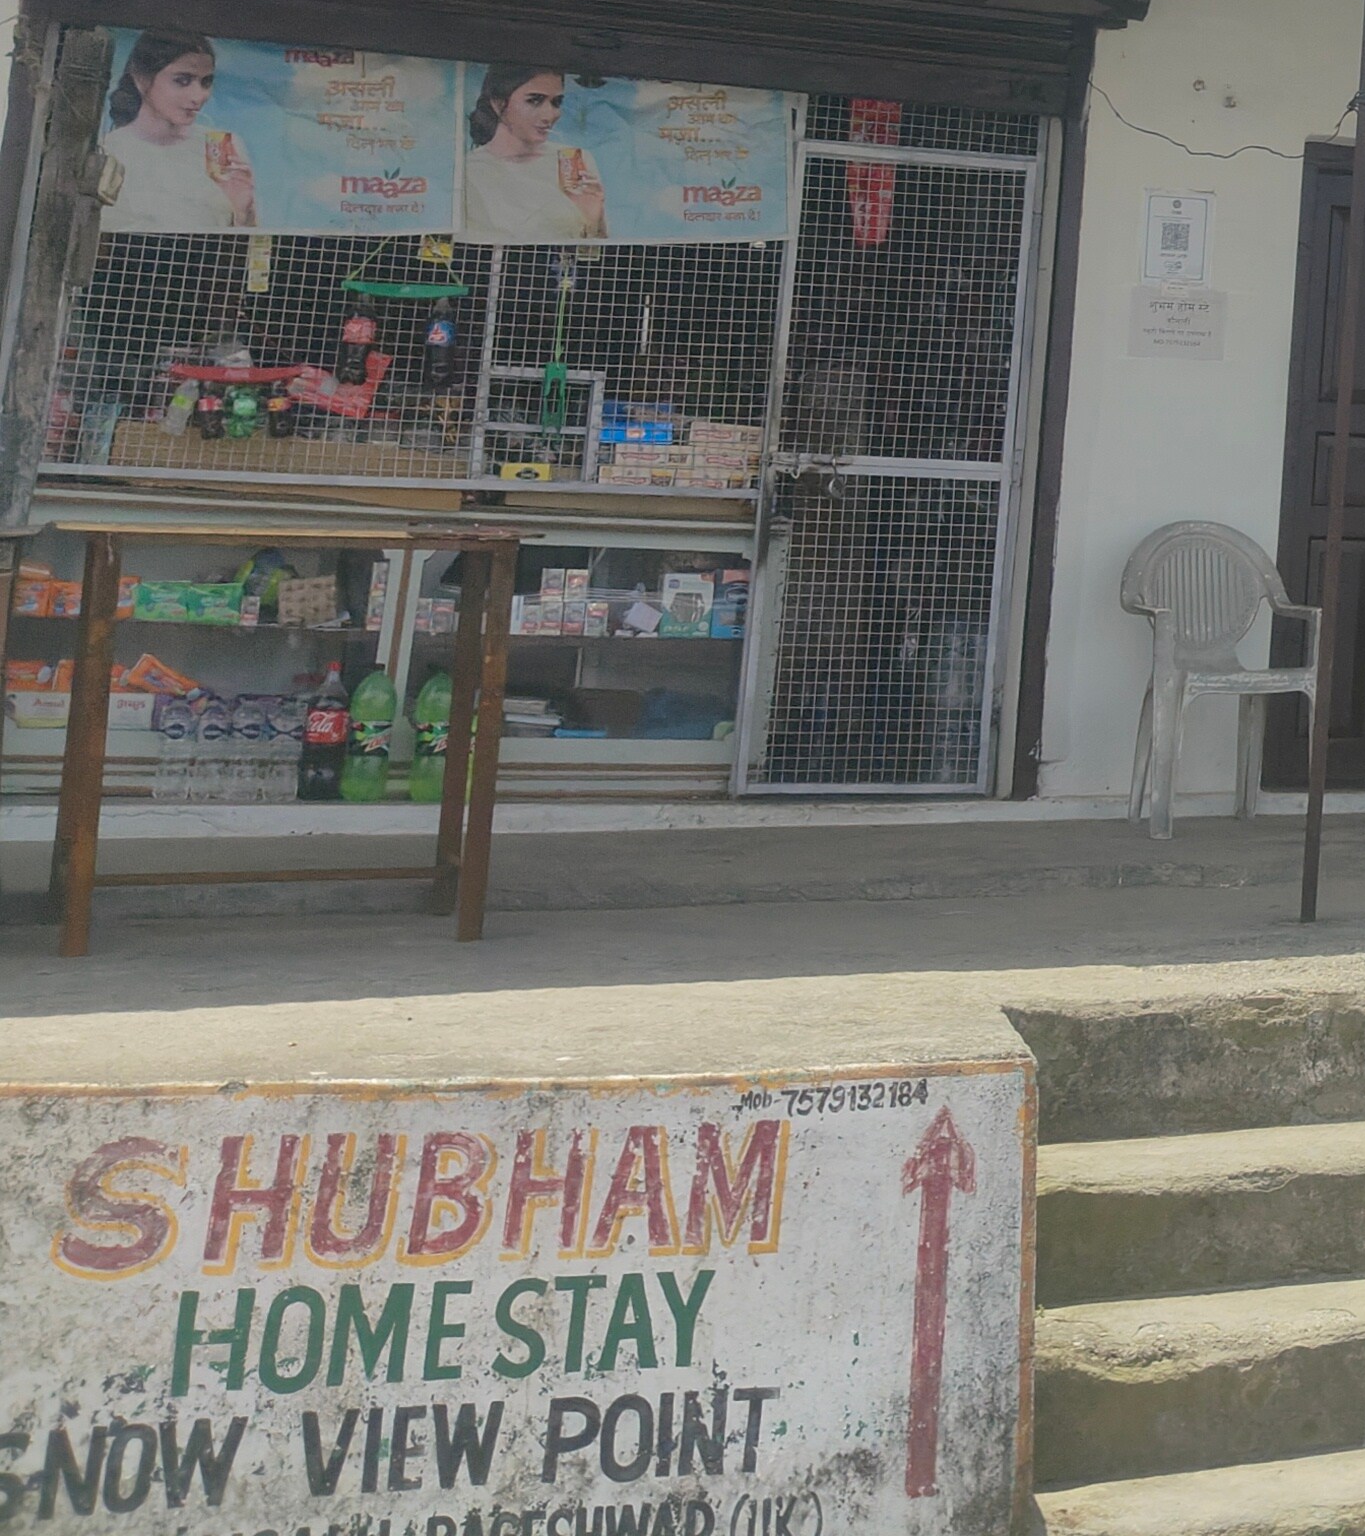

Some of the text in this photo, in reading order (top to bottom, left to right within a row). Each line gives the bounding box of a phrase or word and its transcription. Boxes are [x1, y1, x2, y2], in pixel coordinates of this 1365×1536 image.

[341, 175, 427, 198] maaza
[682, 185, 762, 206] maaza
[50, 1120, 790, 1281] SHUBHAM
[171, 1269, 716, 1397] HOME STAY
[302, 1401, 504, 1497] VIEW
[541, 1387, 781, 1484] POINT
